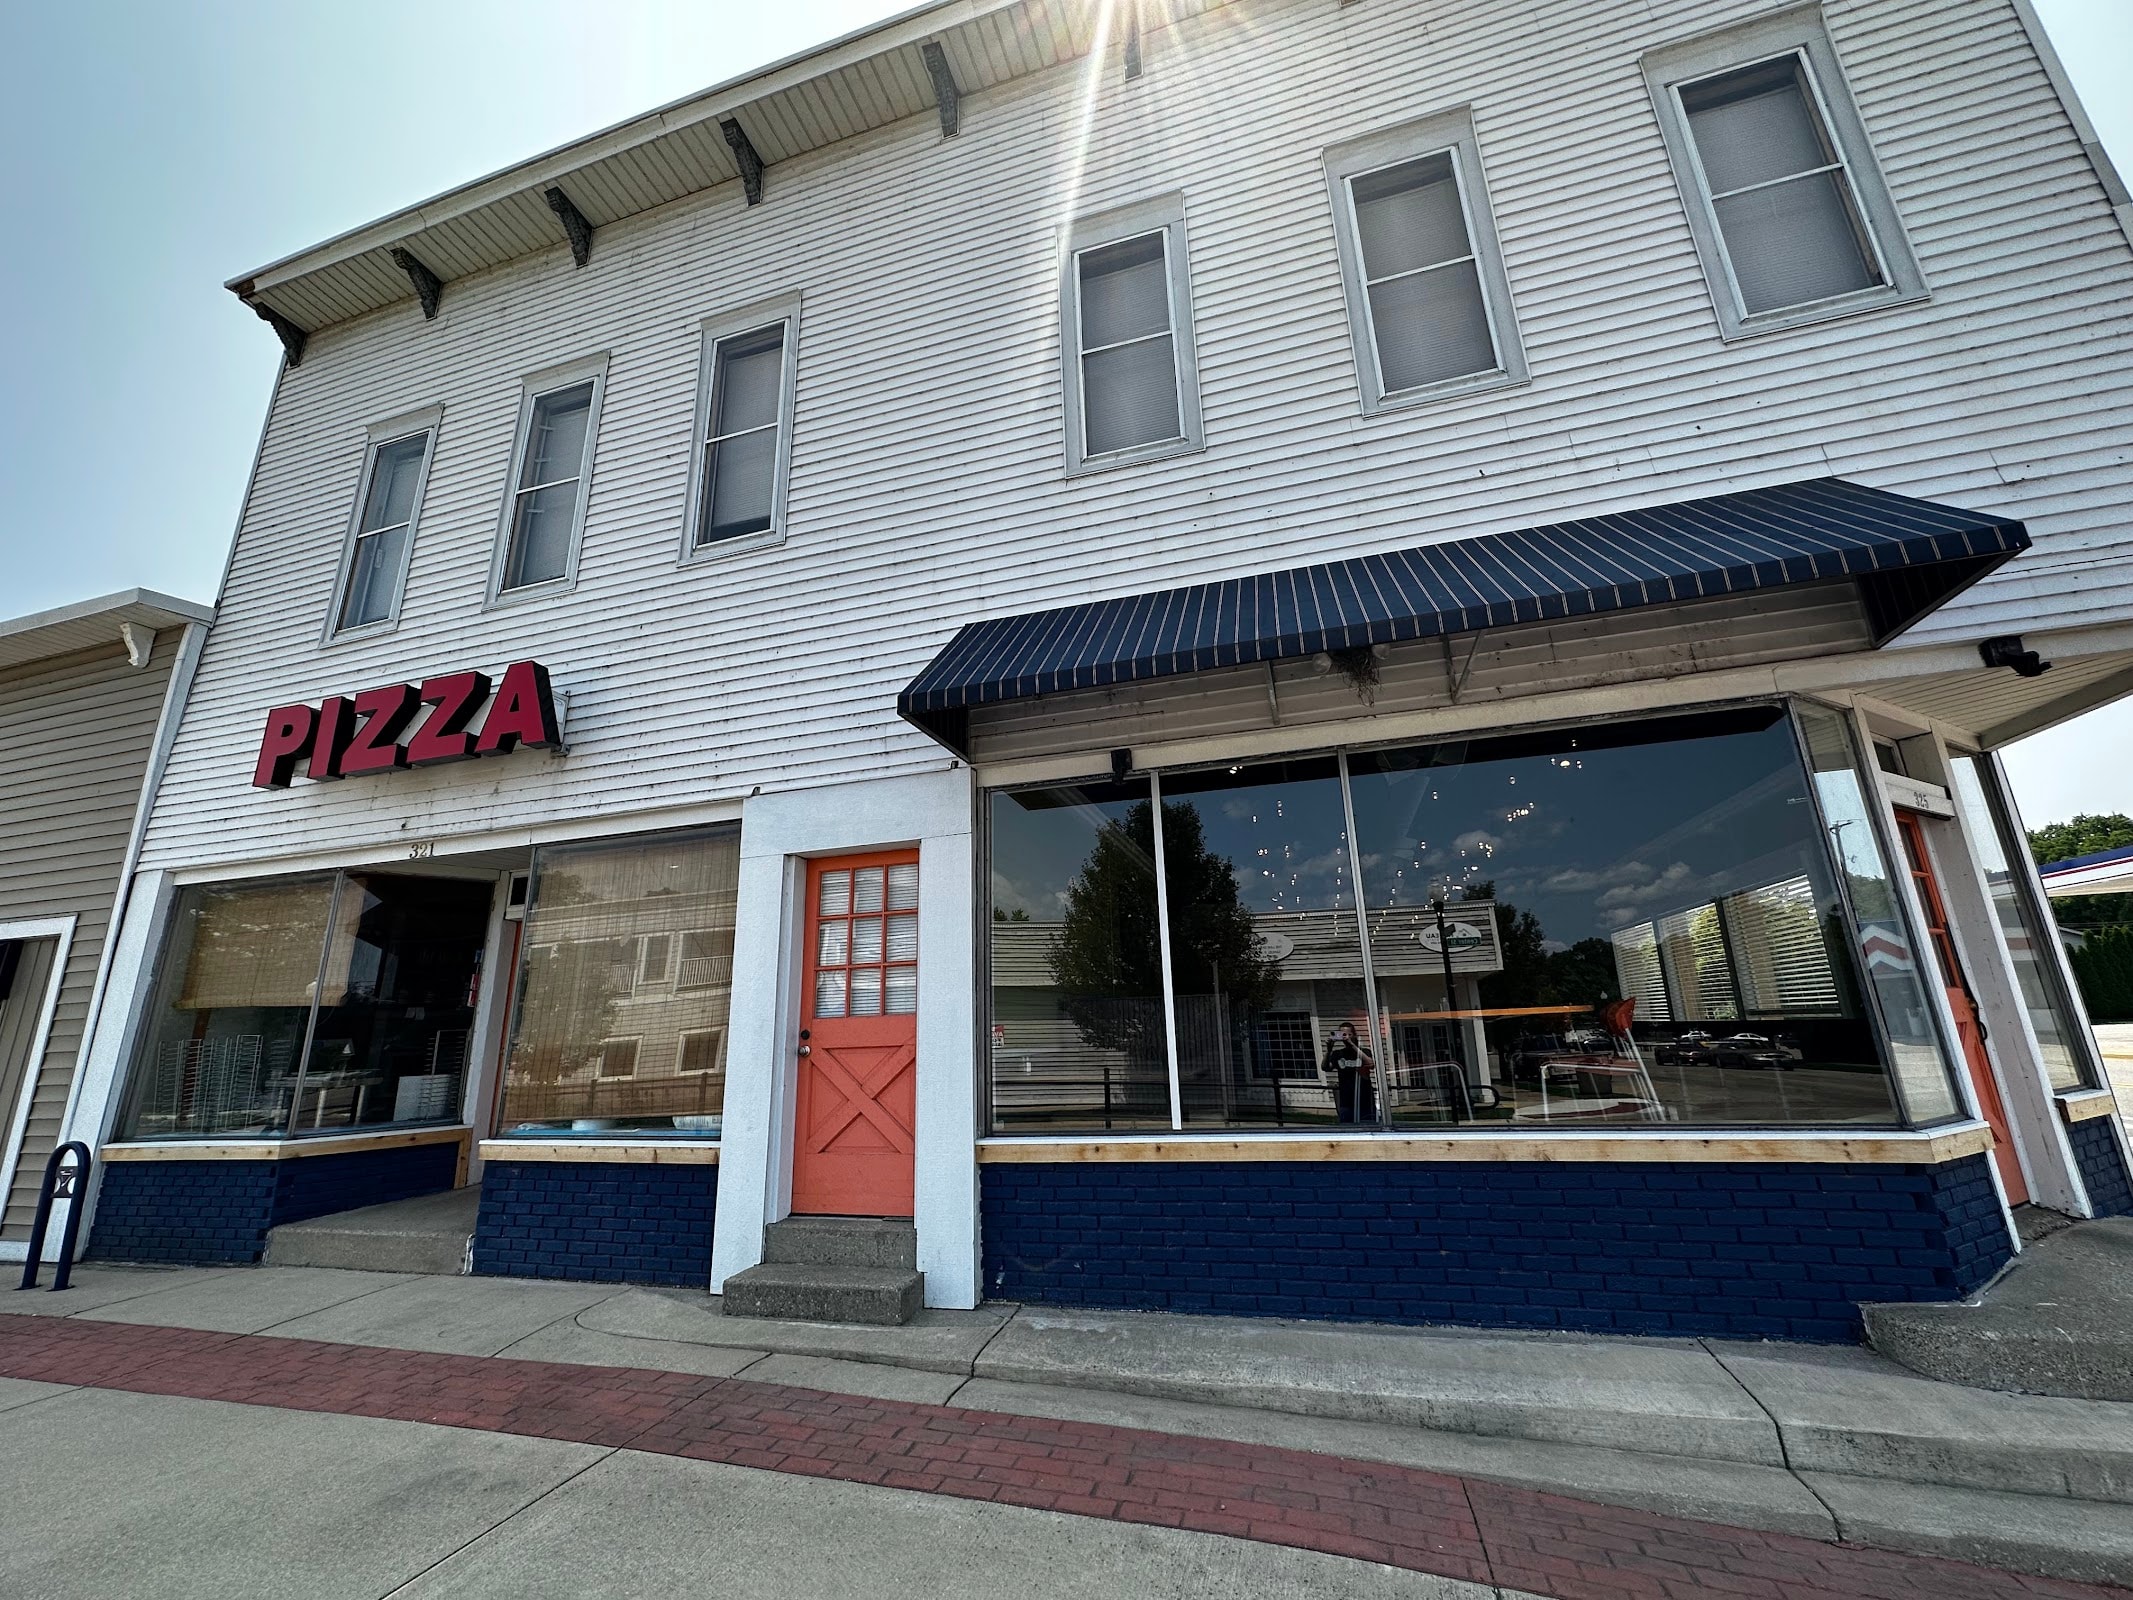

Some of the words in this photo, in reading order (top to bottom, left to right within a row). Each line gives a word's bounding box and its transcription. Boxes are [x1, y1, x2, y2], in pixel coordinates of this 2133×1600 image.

[252, 660, 558, 789] PIZZA
[1914, 791, 1929, 809] 325
[409, 842, 434, 859] 321
